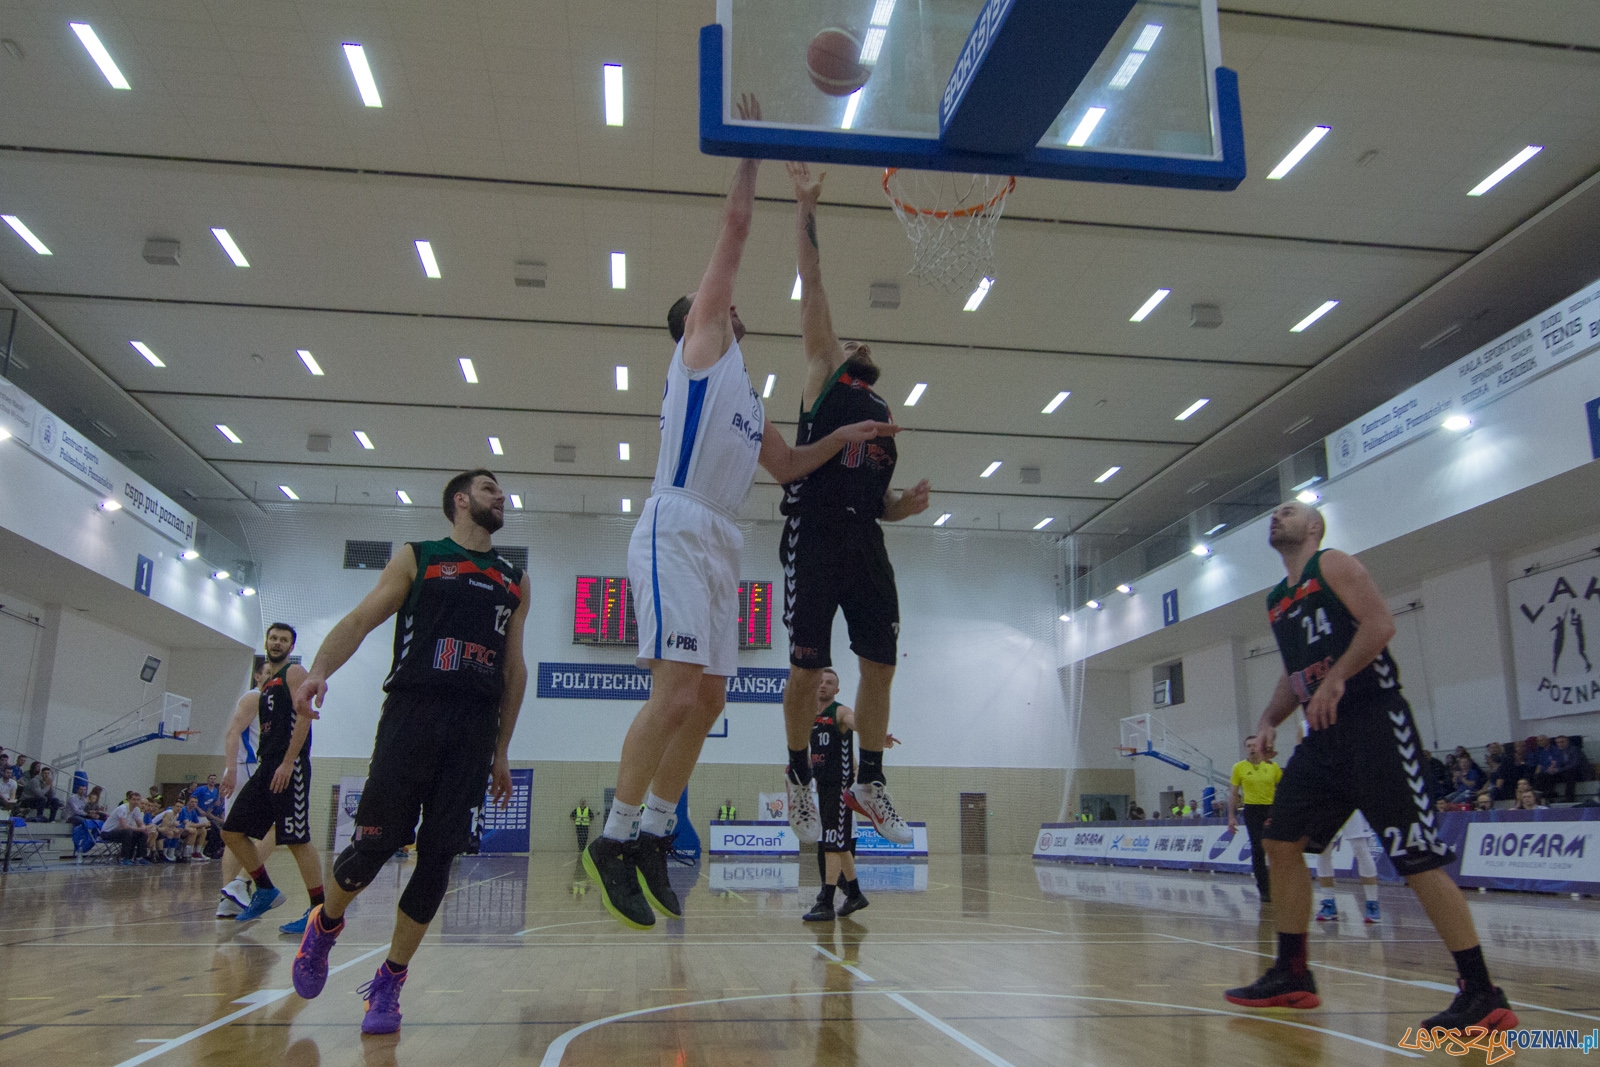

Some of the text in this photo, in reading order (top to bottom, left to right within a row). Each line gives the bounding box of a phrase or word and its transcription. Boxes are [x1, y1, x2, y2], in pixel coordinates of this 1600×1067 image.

[1542, 316, 1583, 350] TENIS
[1458, 328, 1534, 377] HALA SPORTOWA
[1497, 356, 1538, 388] AEROBIK
[1361, 398, 1418, 435] Centrum Sportu
[61, 430, 99, 465] Centrum Sportu
[124, 482, 194, 540] cspp.put.poznan.pl
[140, 562, 149, 591] 1
[468, 578, 494, 591] hummel
[494, 605, 512, 636] 12
[1166, 595, 1174, 622] 1
[1301, 607, 1333, 645] 24
[462, 641, 497, 667] PEC
[675, 635, 698, 652] PBG
[551, 672, 787, 694] POLITECHNI NAŃSKA
[1537, 676, 1600, 705] POZNA
[267, 694, 275, 711] 5
[818, 732, 830, 746] 10
[284, 816, 295, 834] 5
[825, 829, 837, 843] 10
[724, 834, 782, 847] POZnan
[1074, 833, 1105, 846] BIOFARM
[1383, 822, 1428, 857] 24
[1480, 833, 1586, 858] BIOFARM
